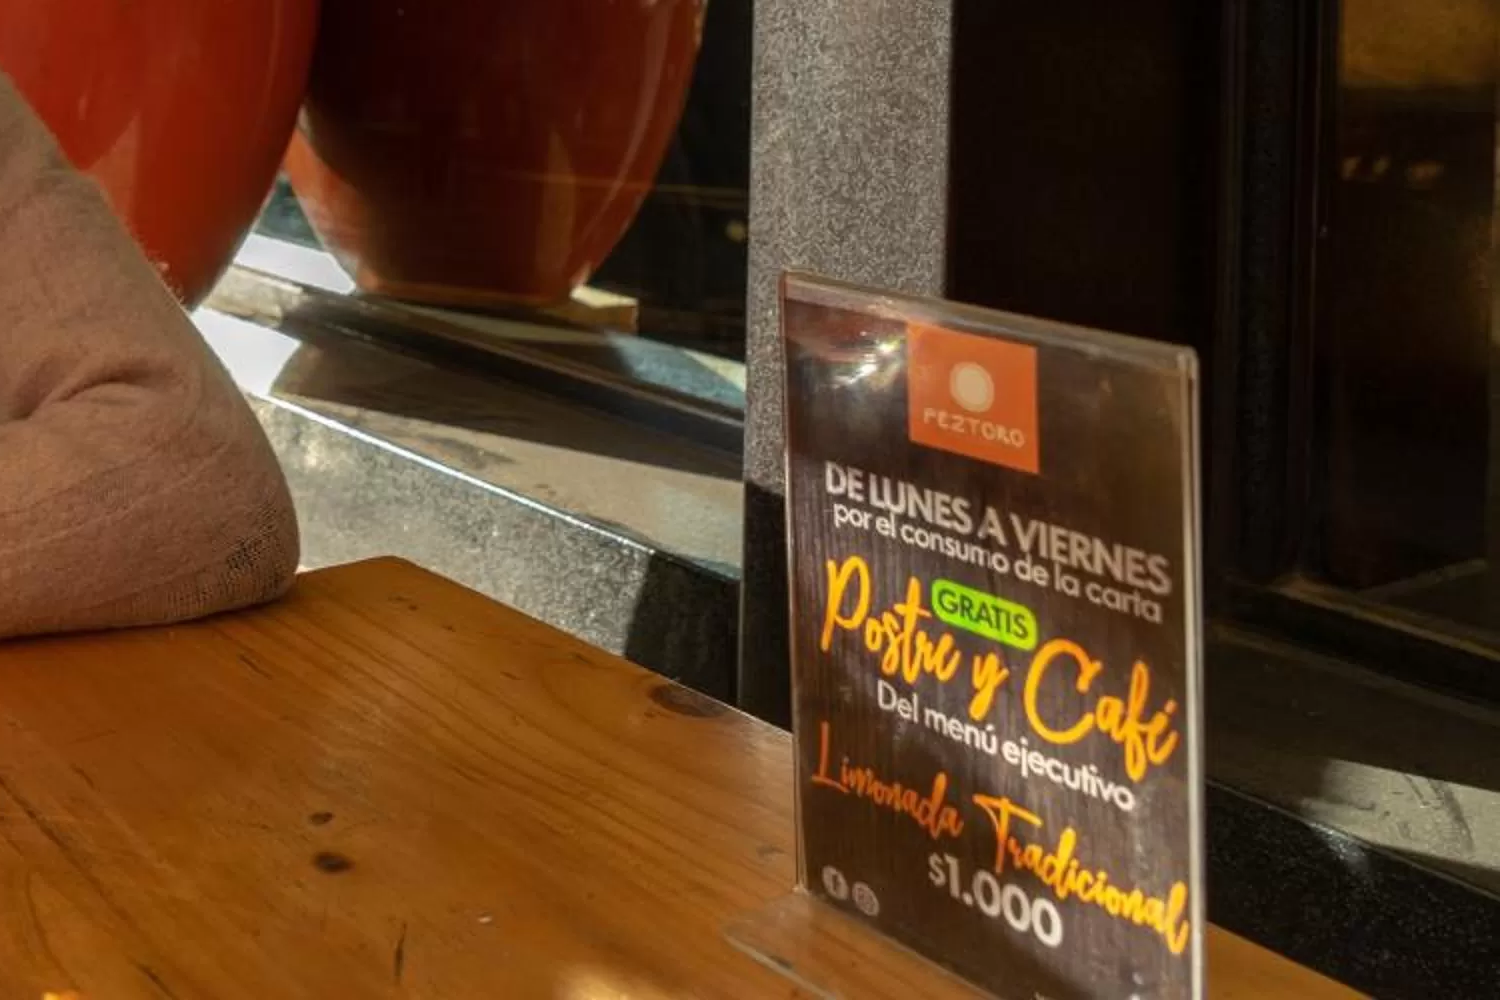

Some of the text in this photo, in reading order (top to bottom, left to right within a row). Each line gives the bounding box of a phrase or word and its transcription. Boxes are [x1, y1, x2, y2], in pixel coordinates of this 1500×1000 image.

[825, 462, 1172, 595] DE LUNES A VIERNES
[833, 503, 1163, 624] por el consumo de la carta
[820, 555, 1179, 783] Postre y Café
[937, 588, 1029, 640] GRATIS
[877, 679, 1136, 811] Del menú ejecutivo
[812, 720, 1190, 954] Limonada Tradicional
[928, 853, 1063, 948] $1.000
